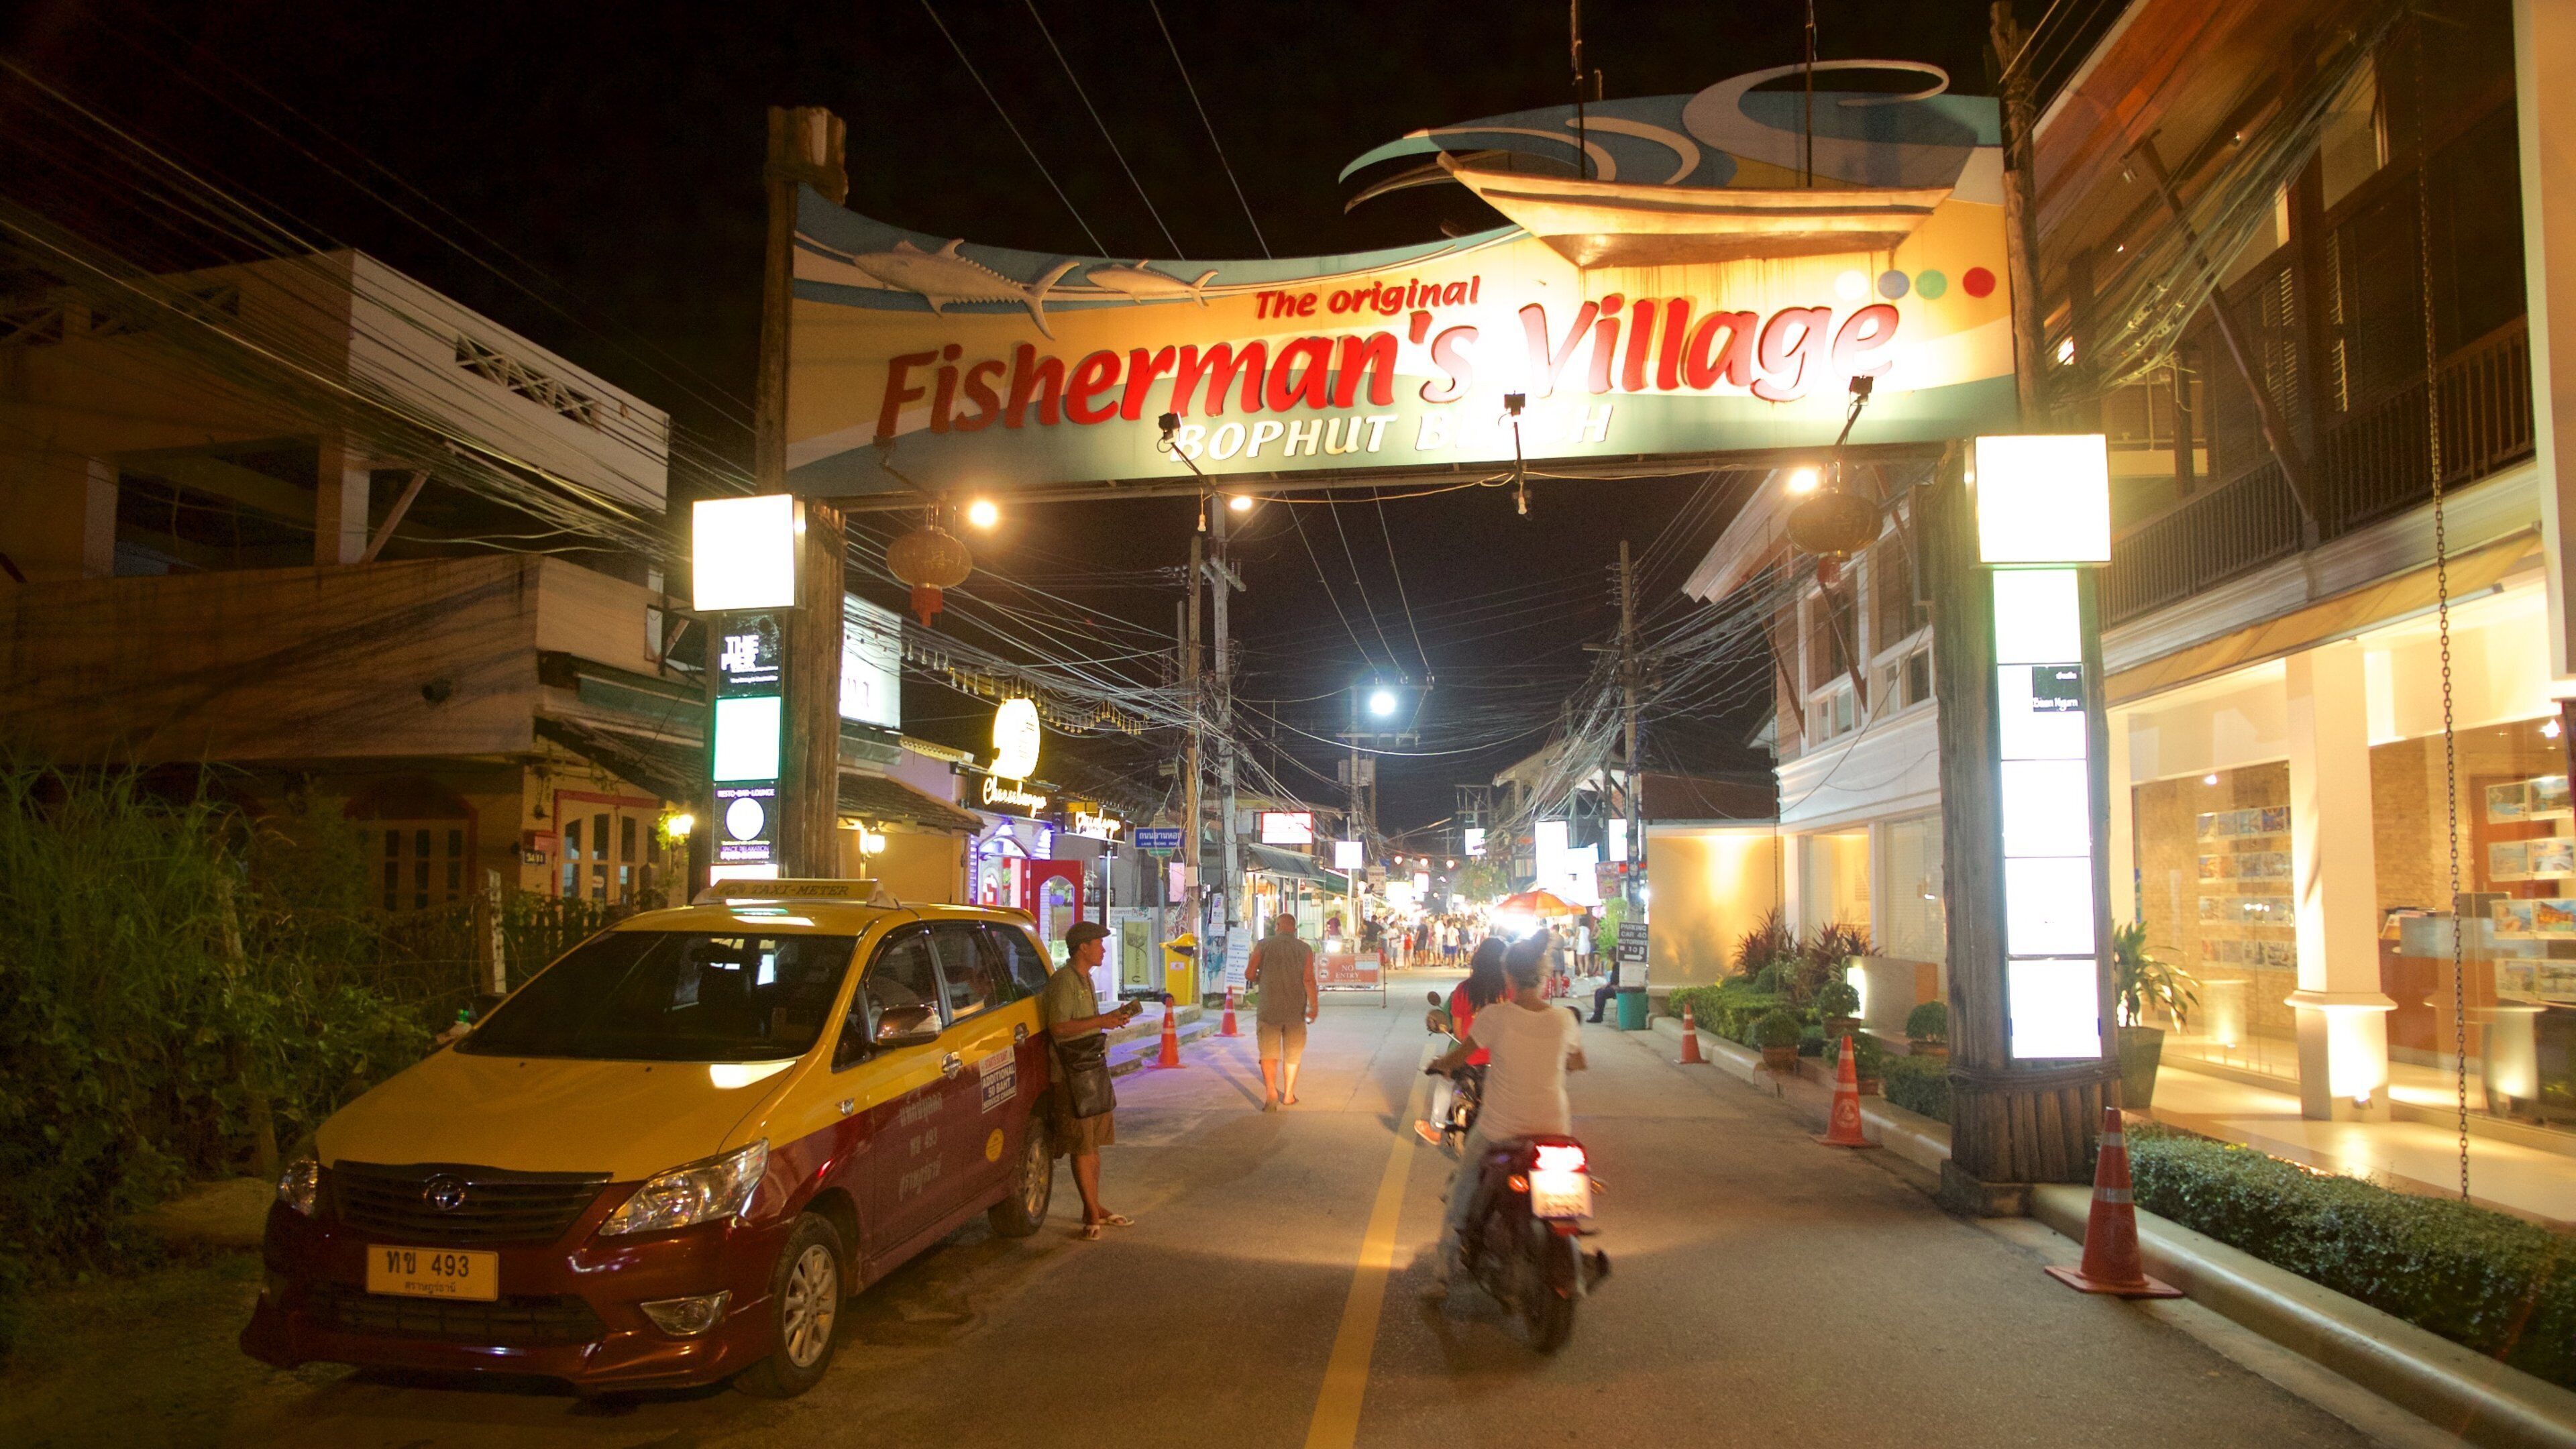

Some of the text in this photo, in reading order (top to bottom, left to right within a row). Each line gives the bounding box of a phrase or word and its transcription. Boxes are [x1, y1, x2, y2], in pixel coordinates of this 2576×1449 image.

[1253, 275, 1481, 320] The original
[874, 292, 1900, 439] Fisherman's Village
[1171, 413, 1399, 463] BOPHUT
[724, 635, 759, 655] THE
[750, 885, 849, 896] TAXI-METER
[386, 1250, 469, 1277] ทข 493
